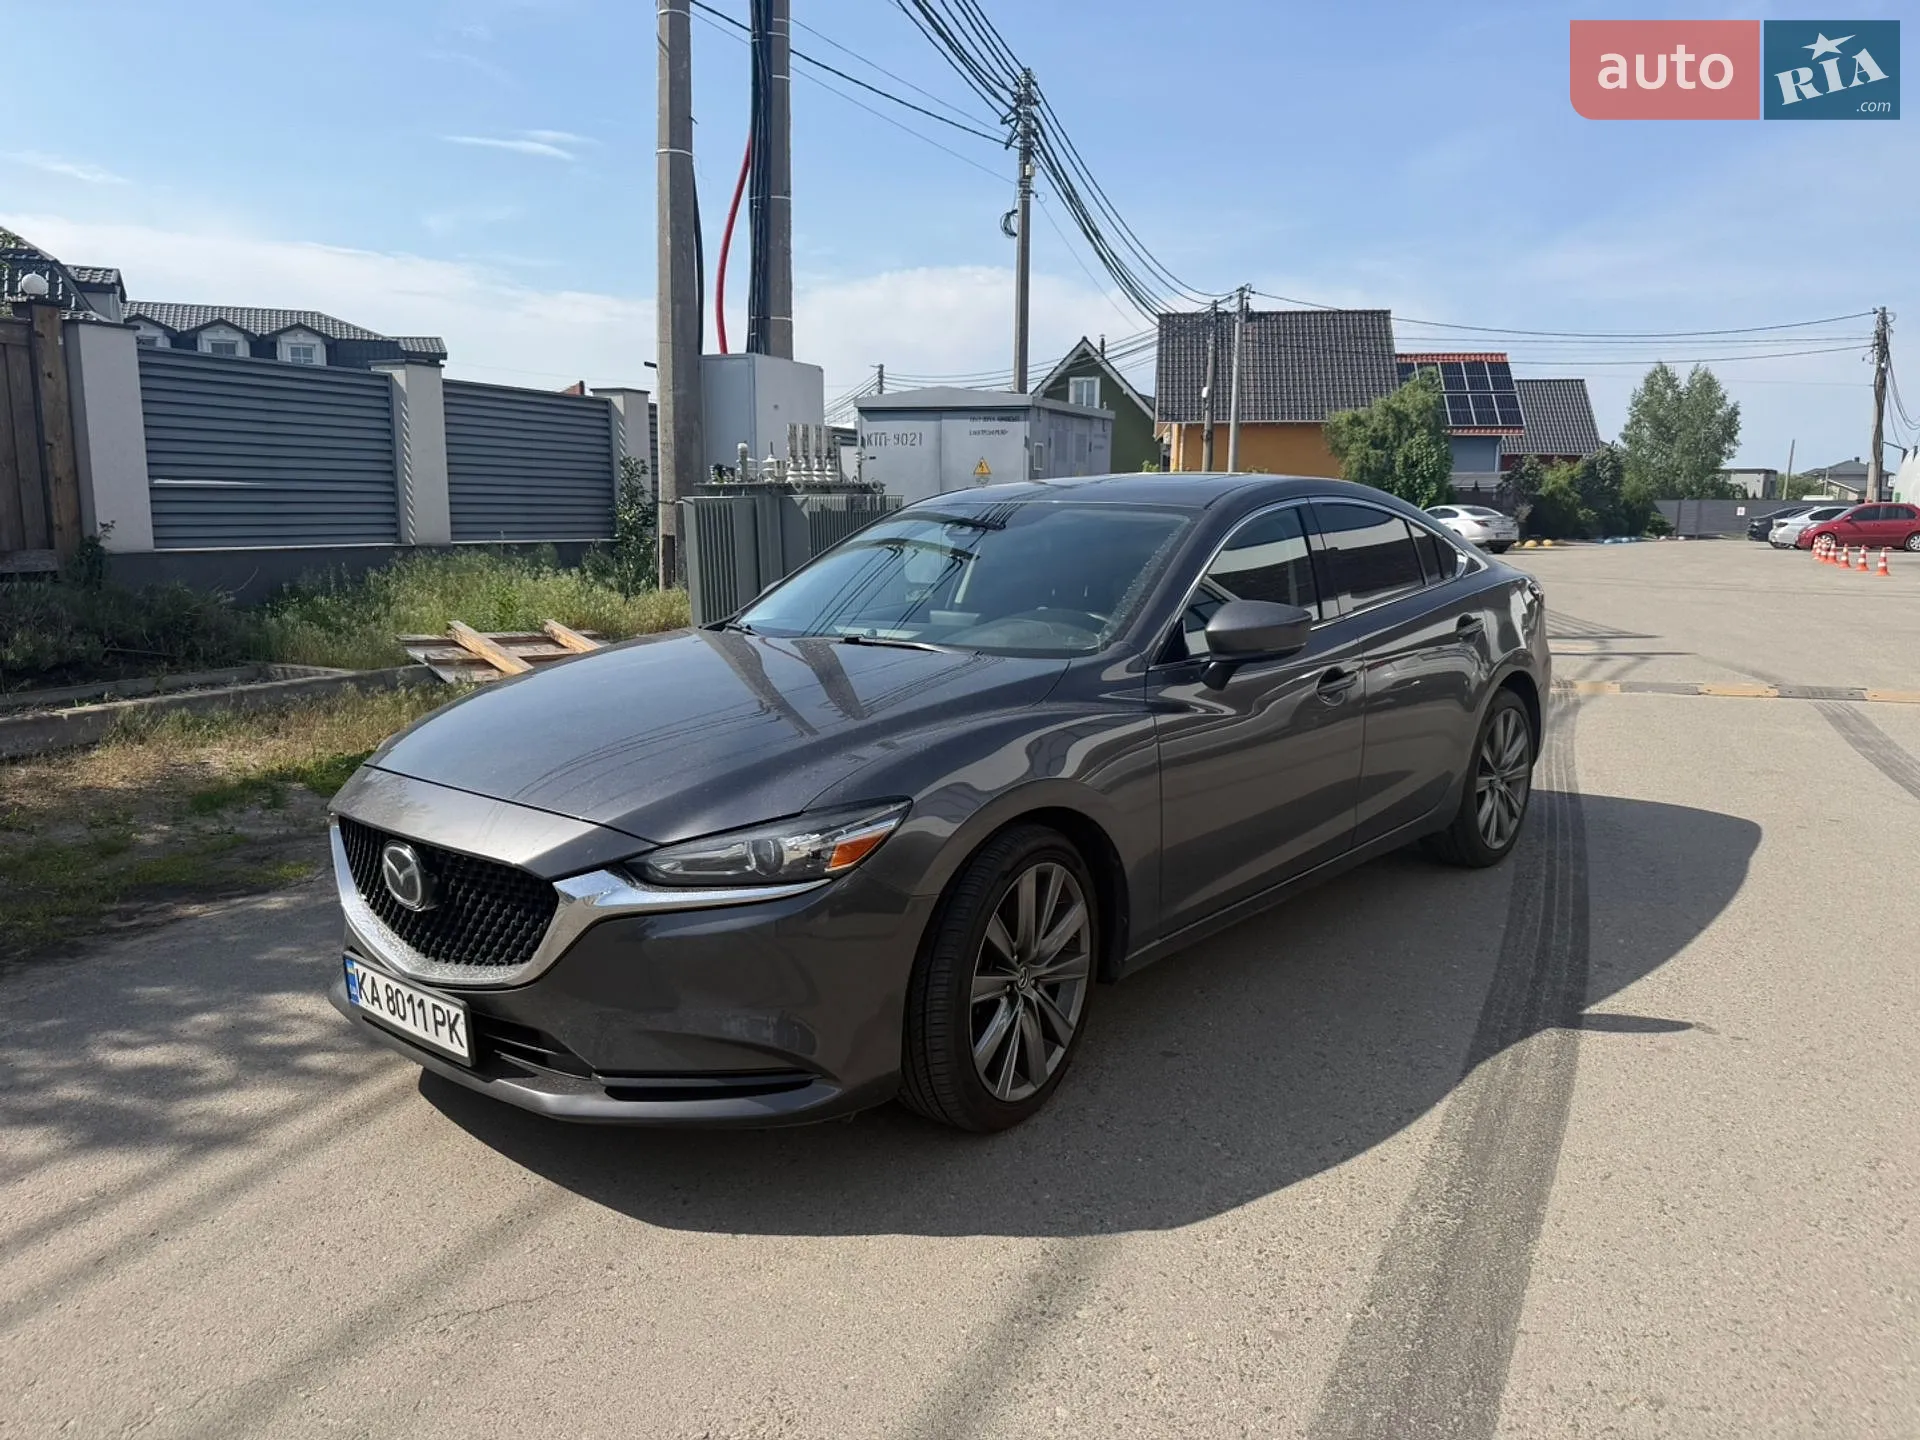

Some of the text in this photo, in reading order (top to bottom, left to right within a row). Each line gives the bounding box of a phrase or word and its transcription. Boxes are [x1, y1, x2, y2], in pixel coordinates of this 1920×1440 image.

[356, 968, 465, 1048] KA 8011 PK
